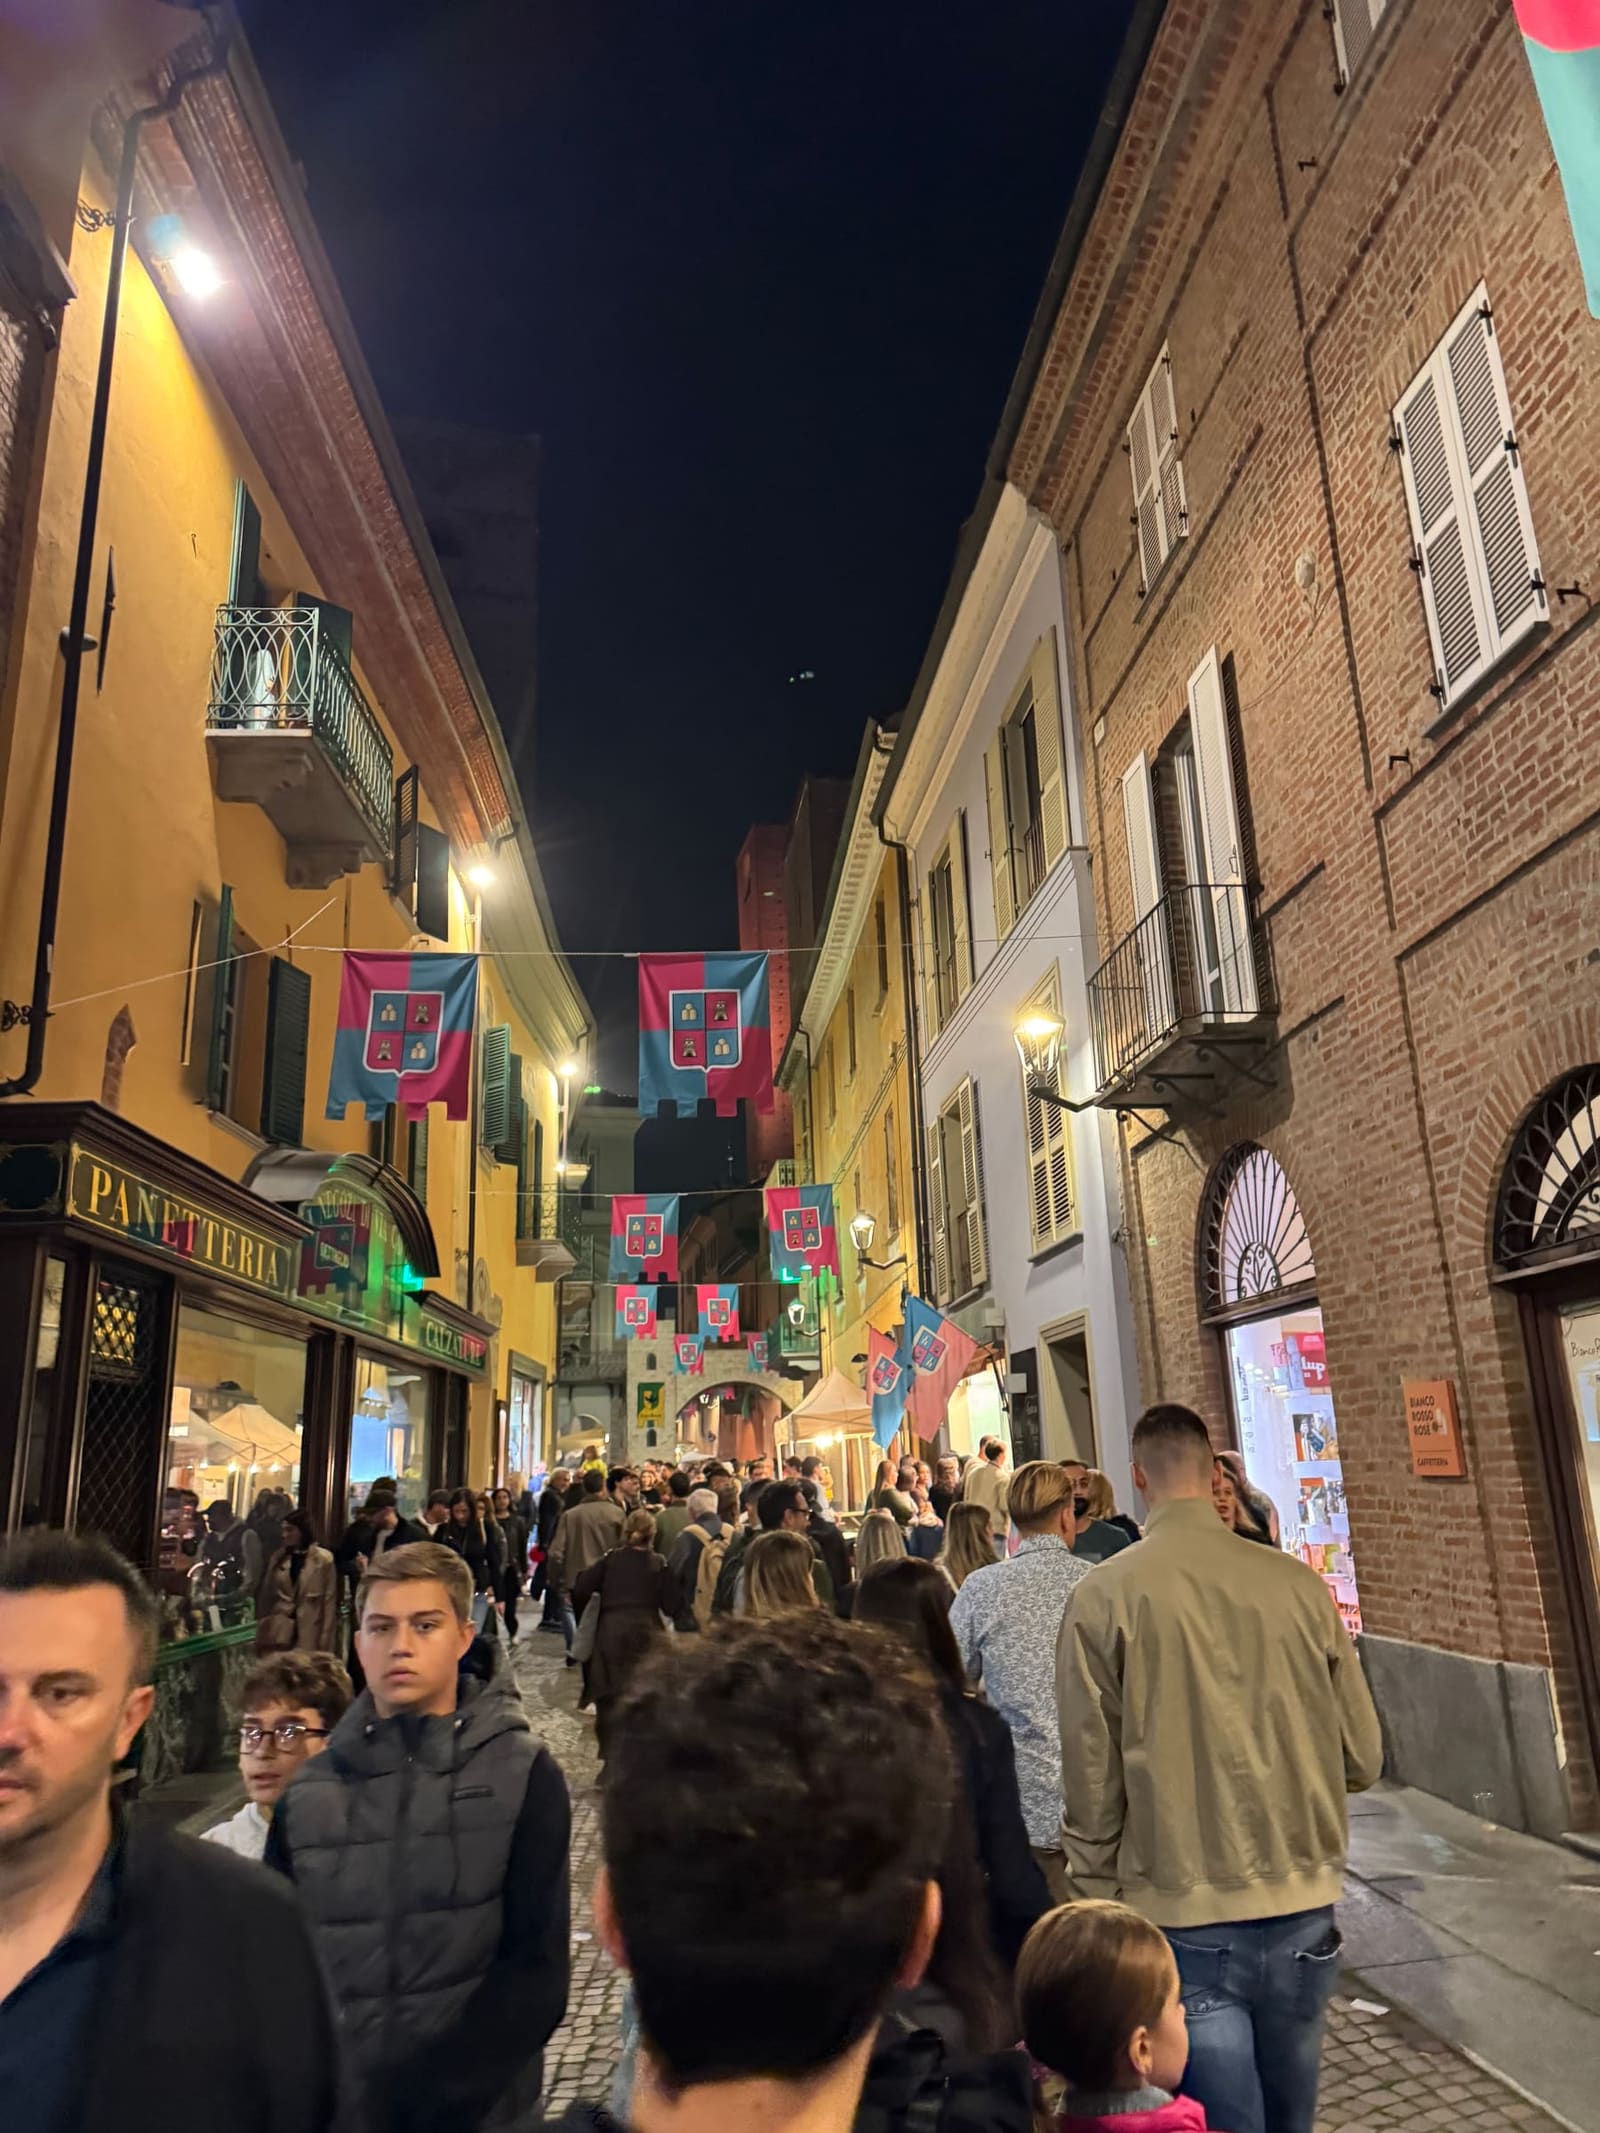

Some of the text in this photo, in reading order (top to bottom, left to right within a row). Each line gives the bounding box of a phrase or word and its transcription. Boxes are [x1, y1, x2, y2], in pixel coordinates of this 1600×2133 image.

[89, 1165, 278, 1286] PANETTERIA
[1409, 1395, 1435, 1408] BIANCO
[1411, 1410, 1434, 1422] ROSSO
[1417, 1457, 1448, 1467] CAFFETTERIA
